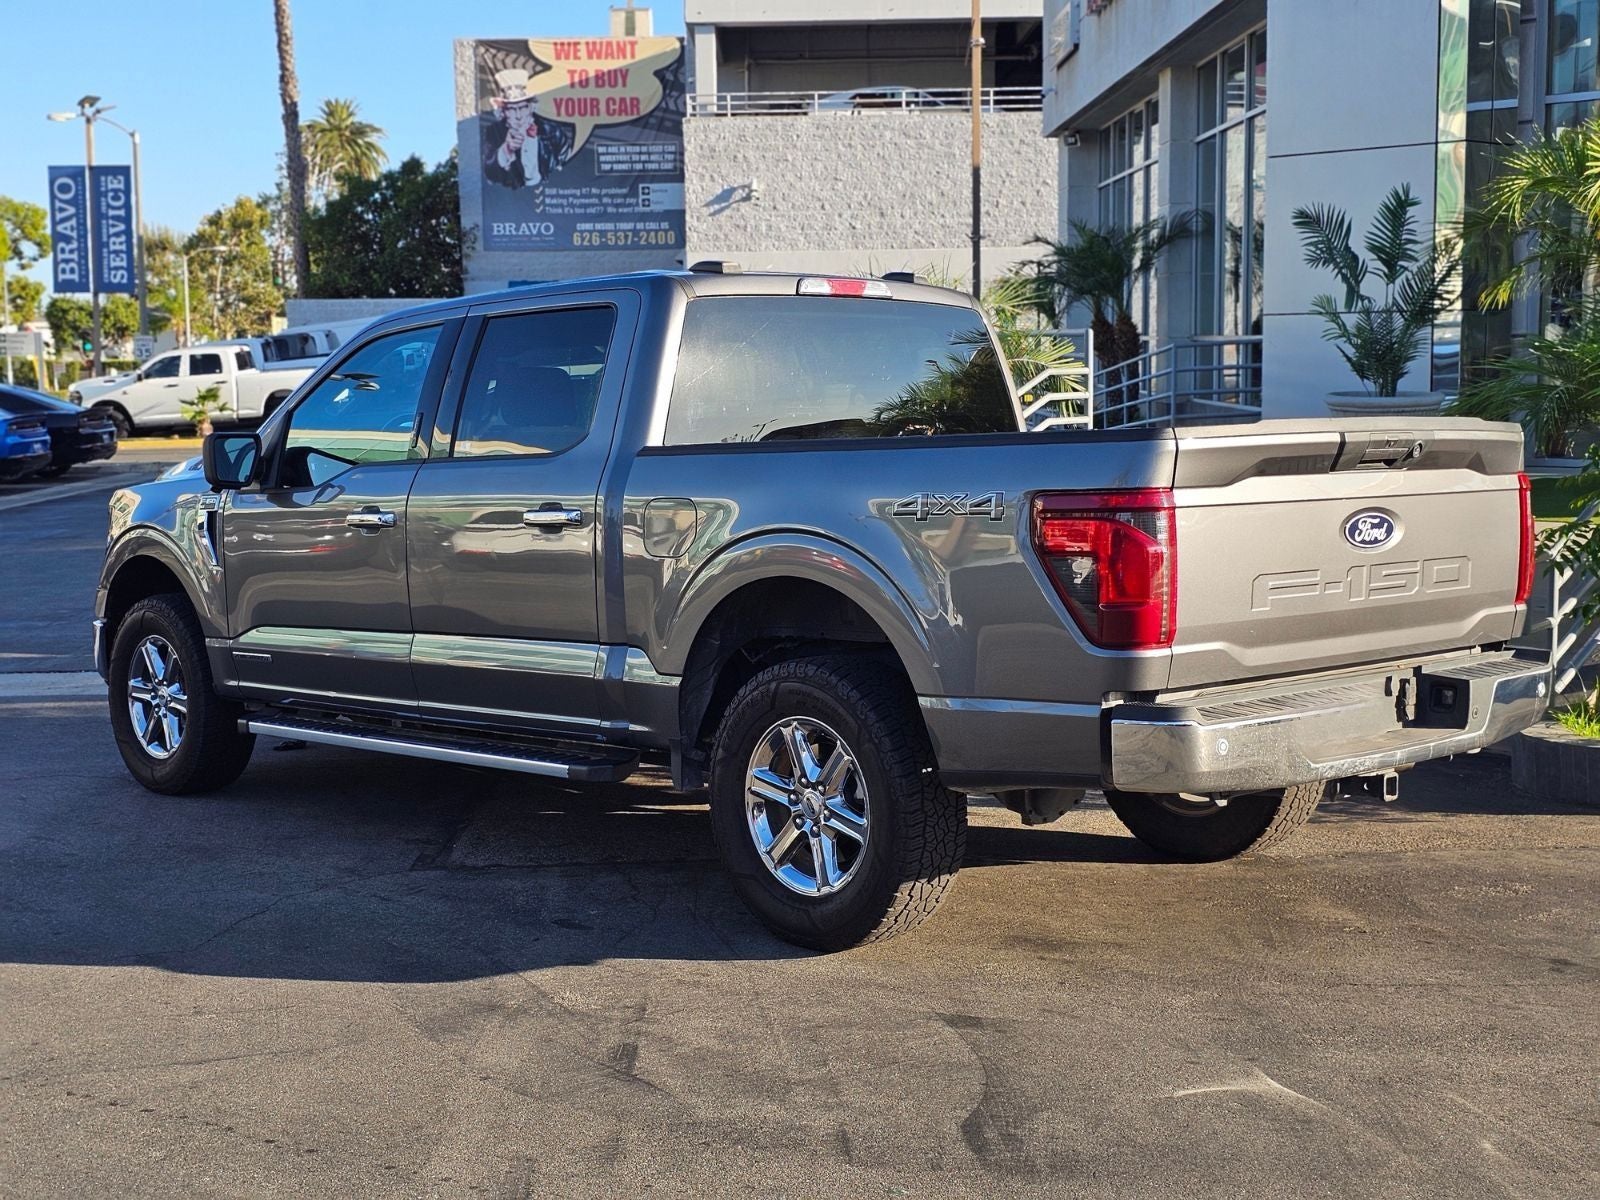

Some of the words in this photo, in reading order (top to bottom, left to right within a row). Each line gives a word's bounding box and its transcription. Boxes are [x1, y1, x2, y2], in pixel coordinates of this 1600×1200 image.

[553, 42, 581, 60] WE
[585, 41, 638, 60] WANT
[567, 69, 589, 89] TO
[594, 68, 629, 88] BUY
[553, 97, 600, 117] YOUR
[605, 96, 640, 117] CAR
[54, 177, 79, 283] BRAVO
[107, 175, 128, 284] SERVICE
[491, 222, 554, 235] BRAVO
[573, 231, 676, 246] 626-537-2400
[1355, 517, 1388, 542] Ford
[1251, 556, 1472, 611] F-150
